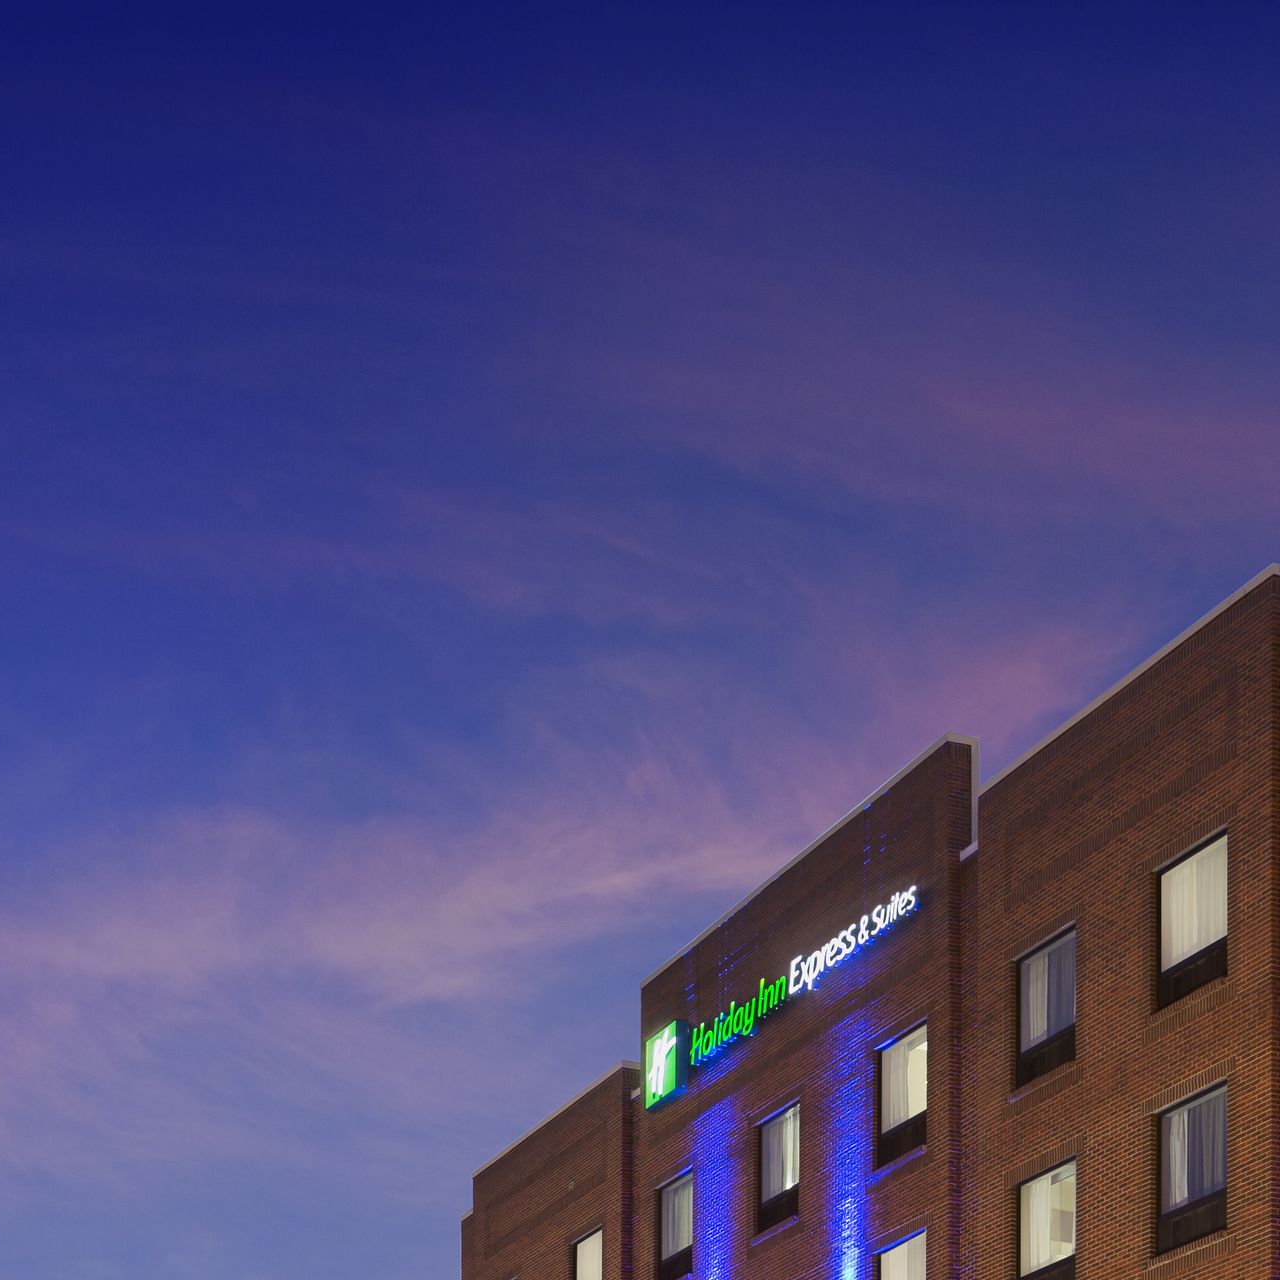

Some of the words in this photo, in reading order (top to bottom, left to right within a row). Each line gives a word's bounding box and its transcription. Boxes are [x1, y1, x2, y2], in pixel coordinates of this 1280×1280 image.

[690, 998, 756, 1065] Holiday
[757, 976, 787, 1017] Inn
[788, 923, 857, 994] Express
[857, 915, 870, 945] &
[870, 885, 917, 935] Suites
